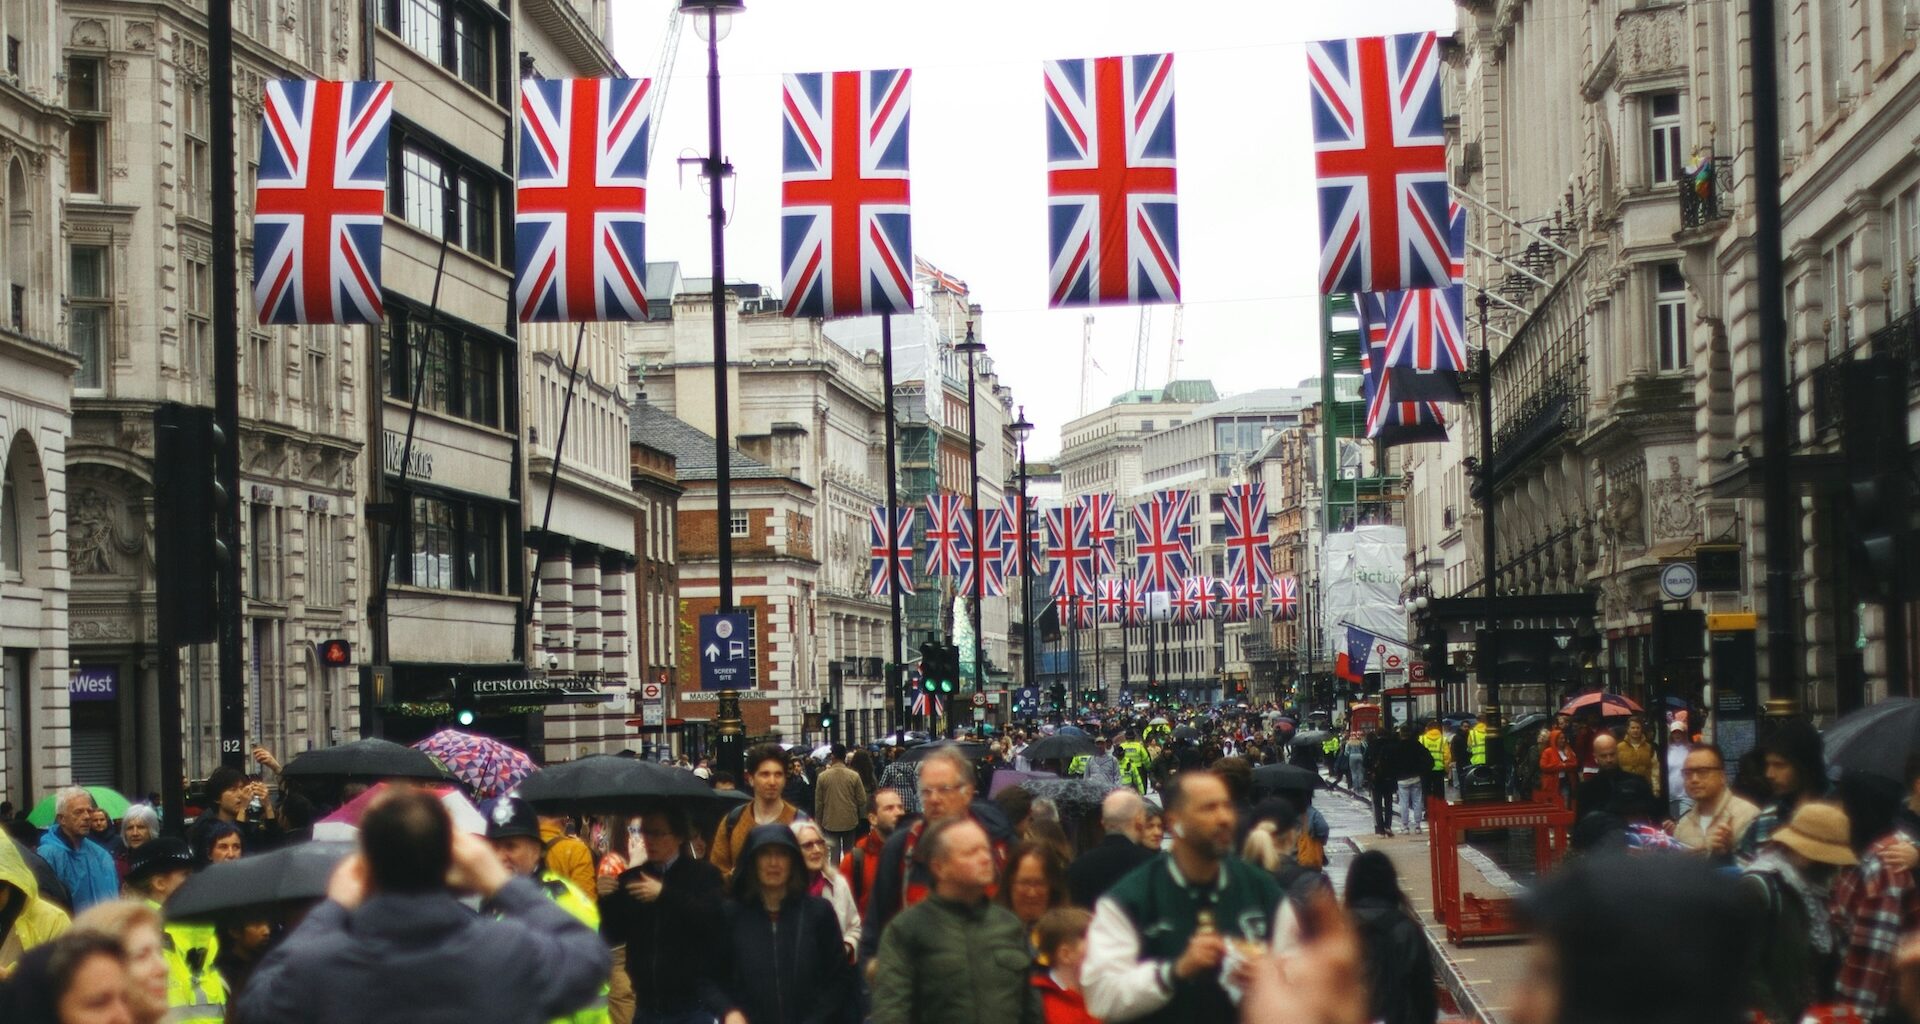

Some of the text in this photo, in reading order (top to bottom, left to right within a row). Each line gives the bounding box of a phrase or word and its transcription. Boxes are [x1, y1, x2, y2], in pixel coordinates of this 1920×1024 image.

[385, 432, 432, 479] Watstones
[1459, 617, 1580, 633] TH DILLY
[70, 675, 112, 692] tWest
[223, 739, 240, 752] 82
